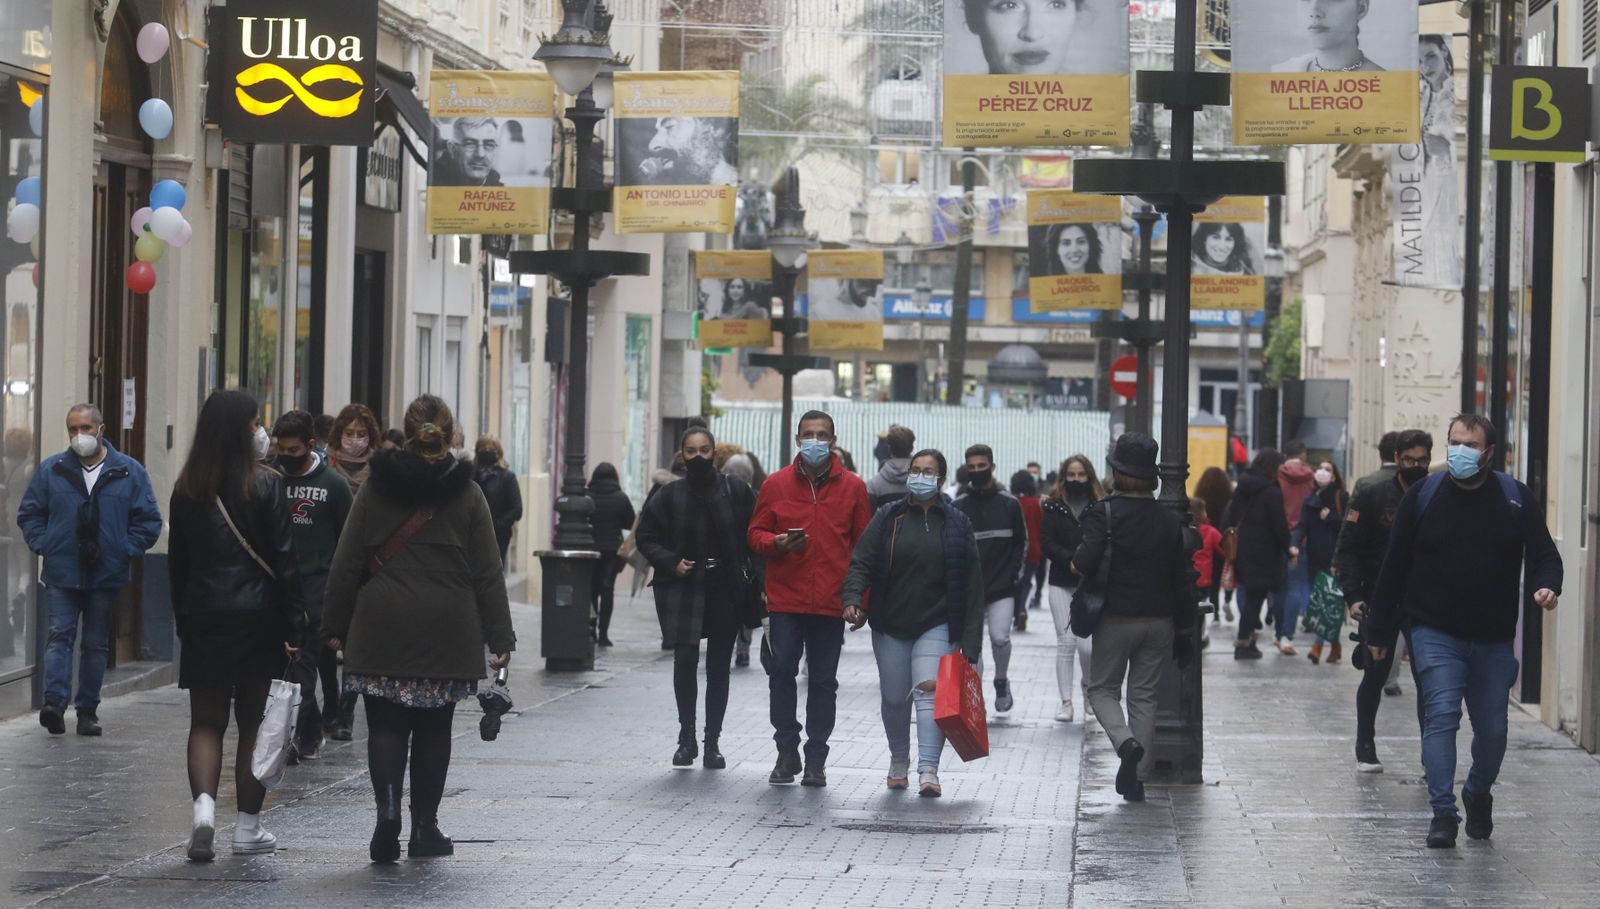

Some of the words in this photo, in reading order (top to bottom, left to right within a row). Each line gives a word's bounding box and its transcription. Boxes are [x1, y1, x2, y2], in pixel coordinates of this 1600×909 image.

[237, 16, 364, 62] Ulloa
[1008, 81, 1064, 95] SILVIA
[1270, 77, 1329, 94] MARÍA
[1333, 76, 1381, 93] JOSÉ
[978, 95, 1038, 112] PÉREZ
[1043, 98, 1093, 112] CRUZ
[1288, 96, 1364, 111] LLERGO
[1511, 77, 1562, 141] B
[464, 190, 511, 200] RAFAEL
[626, 189, 680, 200] ANTONIO
[684, 189, 727, 200] LUQUE
[1400, 171, 1423, 275] MATILDE
[1056, 276, 1096, 286] RAQUEL
[1051, 284, 1102, 296] LANSEROS
[1194, 286, 1240, 294] LLAMERO
[286, 486, 328, 502] LISTER
